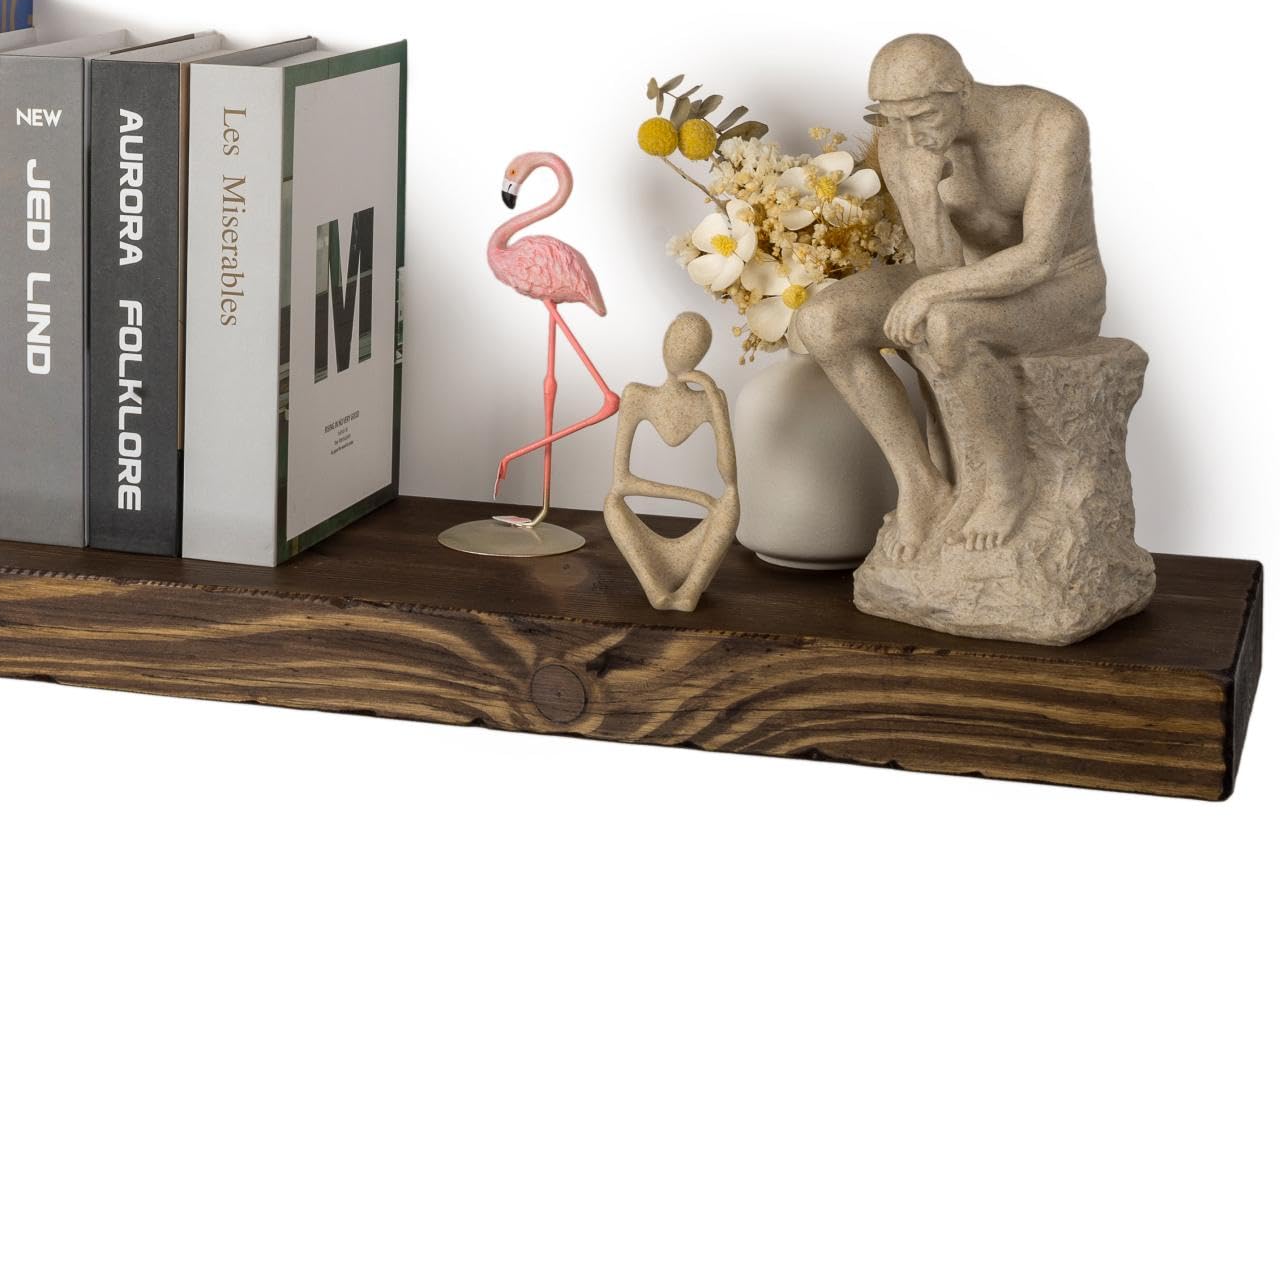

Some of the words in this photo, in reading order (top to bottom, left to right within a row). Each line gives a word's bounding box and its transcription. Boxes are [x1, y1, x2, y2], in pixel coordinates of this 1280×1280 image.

[16, 107, 63, 127] NEW
[223, 106, 247, 156] Les
[26, 158, 51, 251] JED
[118, 108, 144, 267] AURORA
[220, 174, 247, 327] Miserables
[26, 272, 51, 375] LIND
[313, 206, 375, 384] M
[117, 299, 143, 512] FOLKLORE
